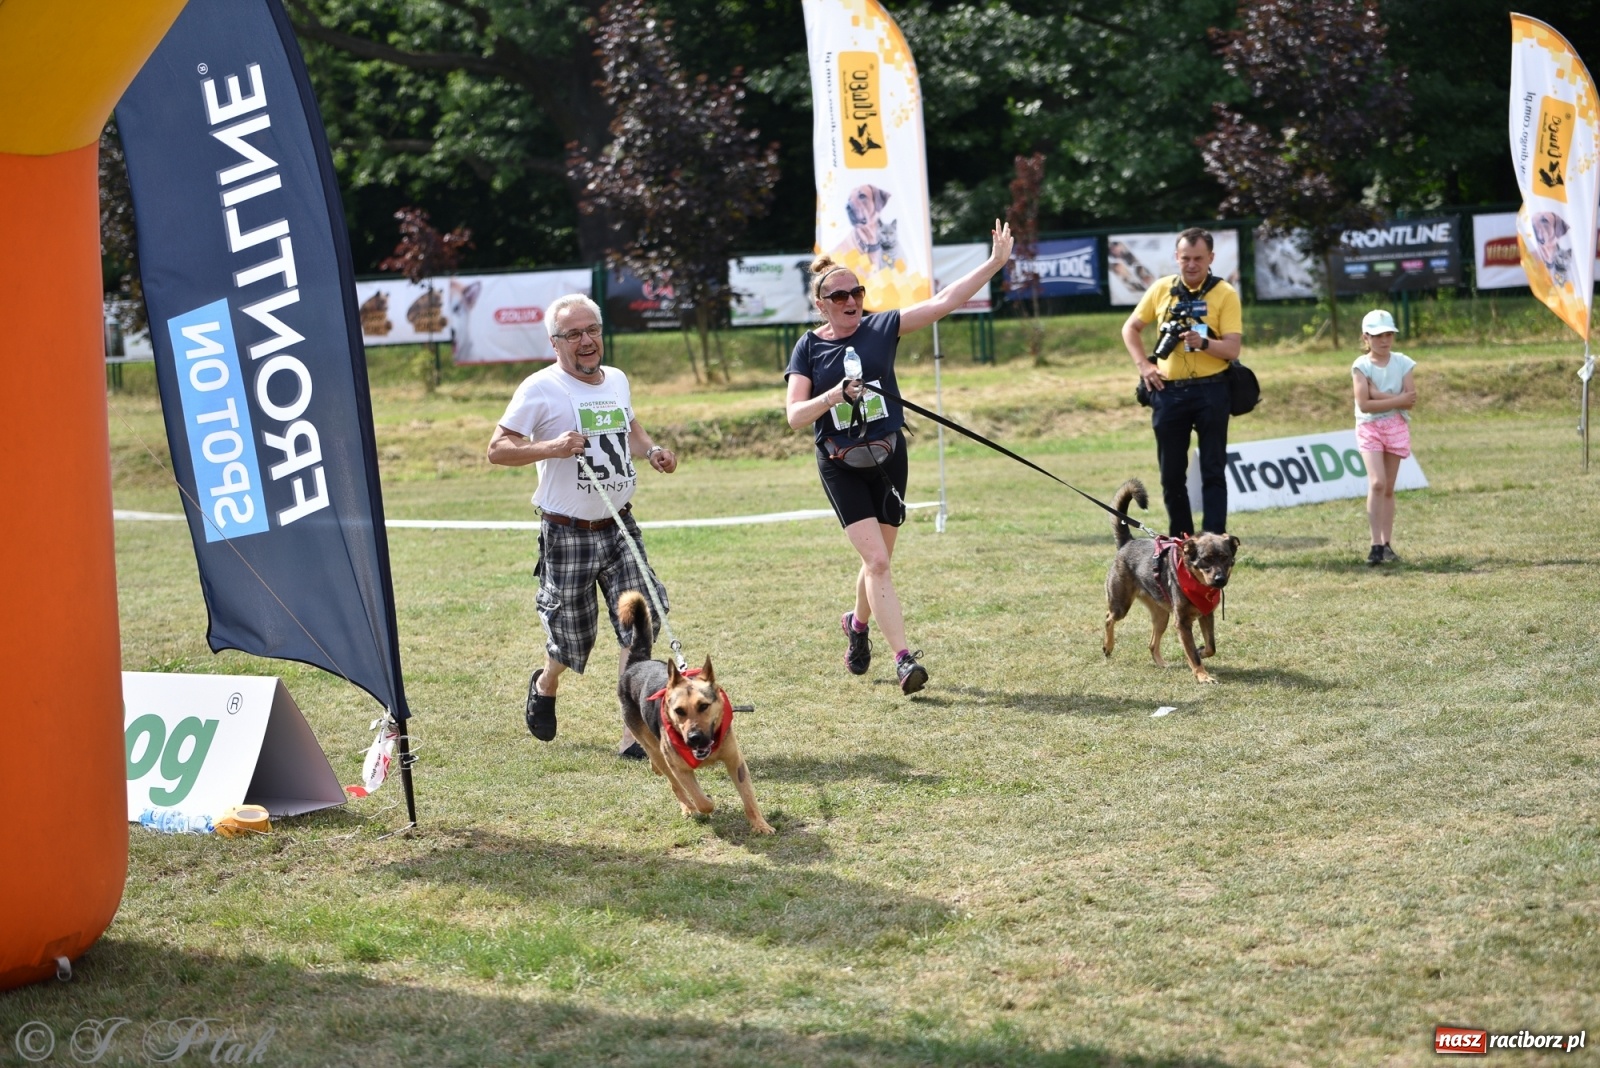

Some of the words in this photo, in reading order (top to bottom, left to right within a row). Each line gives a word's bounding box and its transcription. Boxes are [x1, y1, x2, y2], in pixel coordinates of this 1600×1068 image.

[1060, 253, 1092, 278] DOG
[595, 413, 612, 427] 34
[1227, 443, 1367, 494] TropiDo
[124, 713, 219, 807] og
